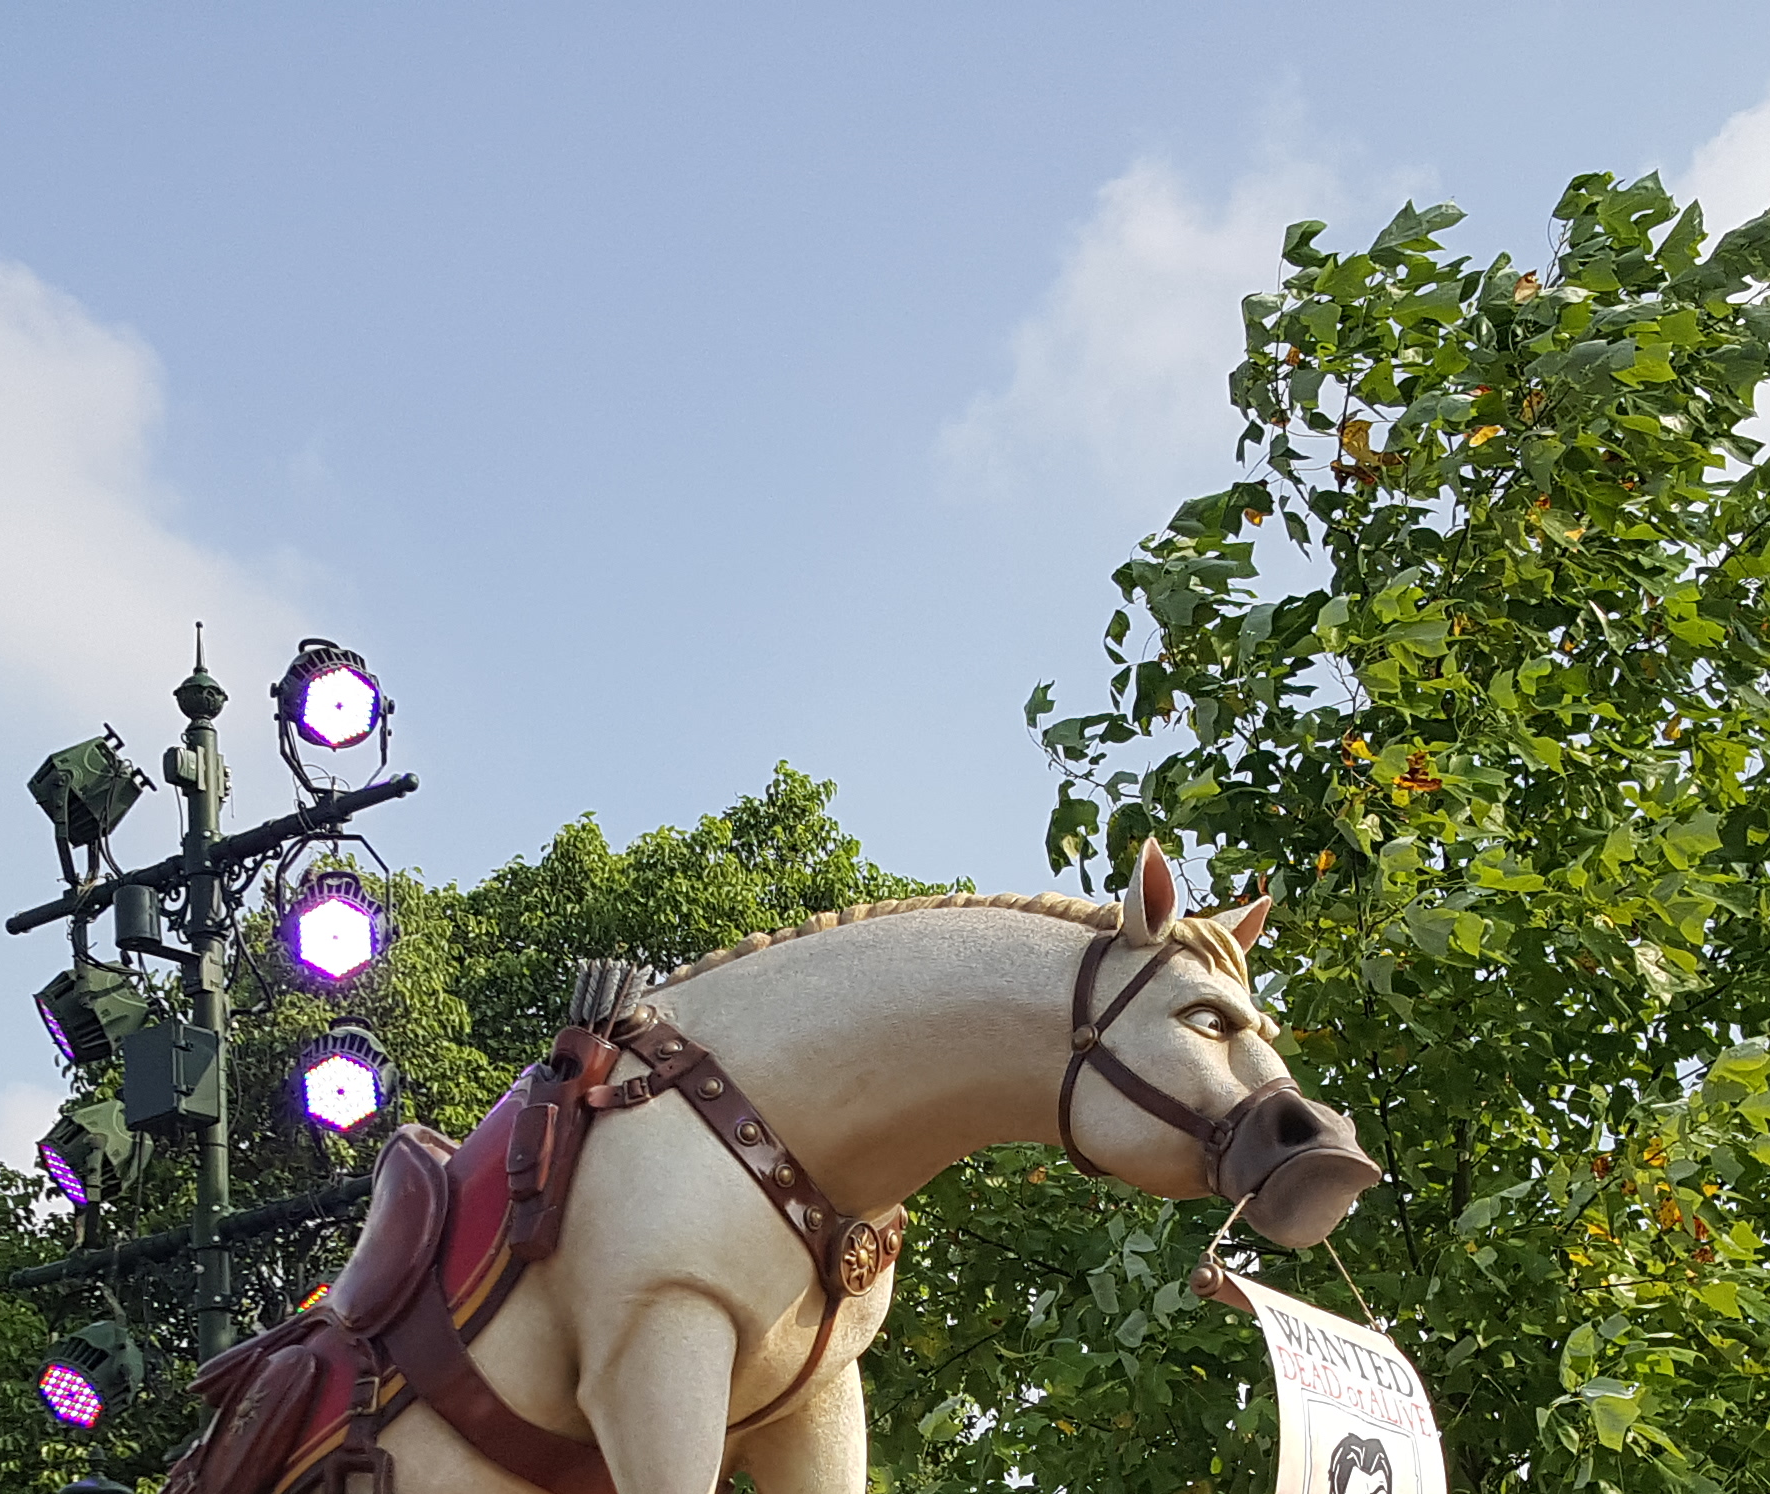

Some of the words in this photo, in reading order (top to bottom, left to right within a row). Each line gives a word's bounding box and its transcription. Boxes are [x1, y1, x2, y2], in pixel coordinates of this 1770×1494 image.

[1265, 1305, 1414, 1398] WANTED
[1275, 1344, 1342, 1399] DEAD
[1347, 1386, 1365, 1410] or
[1370, 1386, 1431, 1437] ALIVE
